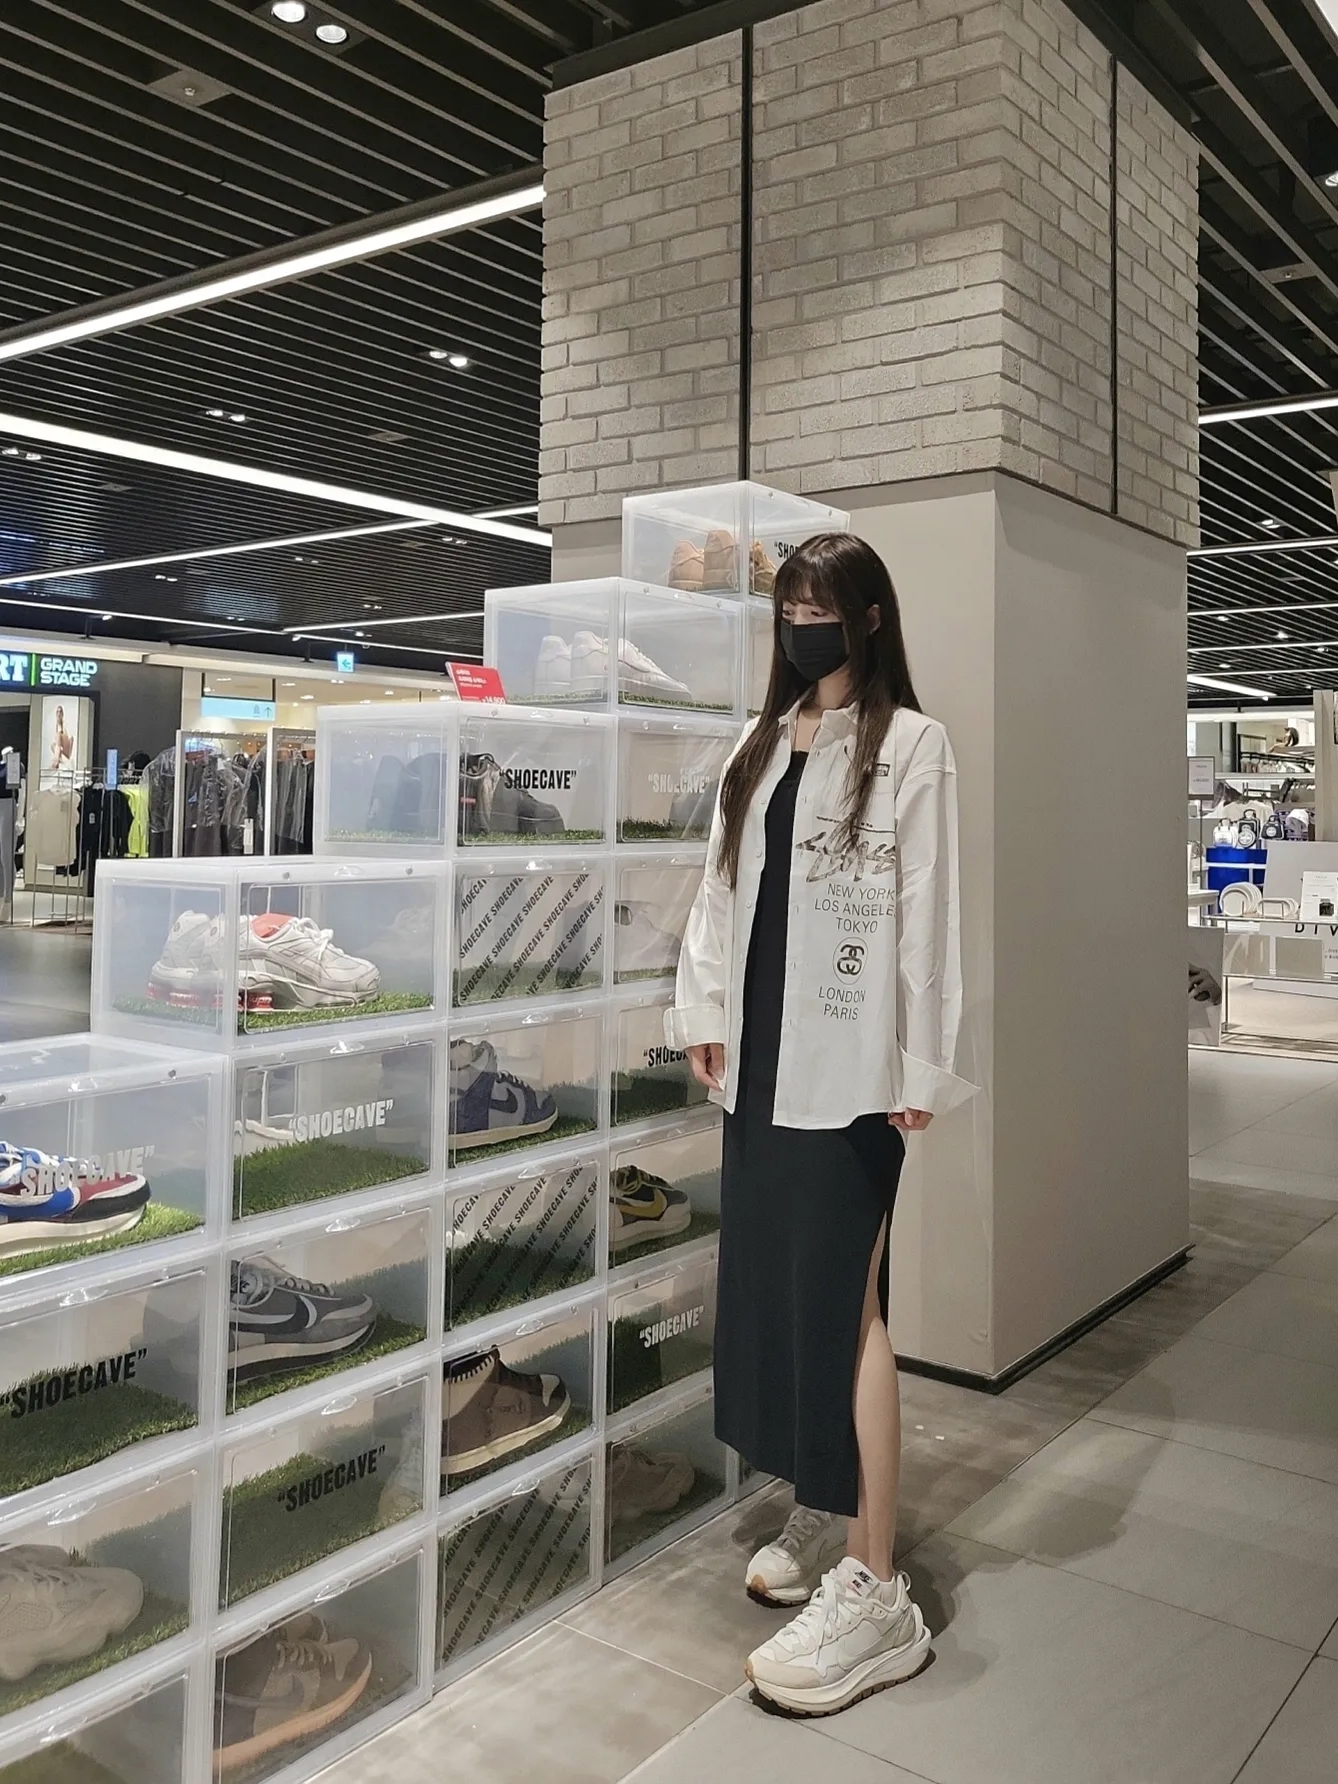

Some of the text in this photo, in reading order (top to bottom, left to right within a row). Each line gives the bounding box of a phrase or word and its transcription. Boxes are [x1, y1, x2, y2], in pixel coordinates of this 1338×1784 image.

[40, 658, 98, 675] GRAND
[40, 671, 91, 687] STAGE
[828, 883, 895, 901] NEW YORK
[814, 898, 896, 918] LOS ANGELE
[491, 913, 525, 957] SHOECAVE
[513, 928, 545, 972] SHOECAVE
[543, 889, 575, 931] SHOECAVE
[836, 917, 878, 934] TOKYO
[818, 985, 866, 1003] LONDON
[823, 1003, 859, 1020] PARIS
[288, 1098, 394, 1142] "SHOECAVE"
[639, 1305, 704, 1349] "SHOECAVE"
[0, 1347, 148, 1419] "SHOECAVE"
[277, 1444, 386, 1512] "SHOECAVE"
